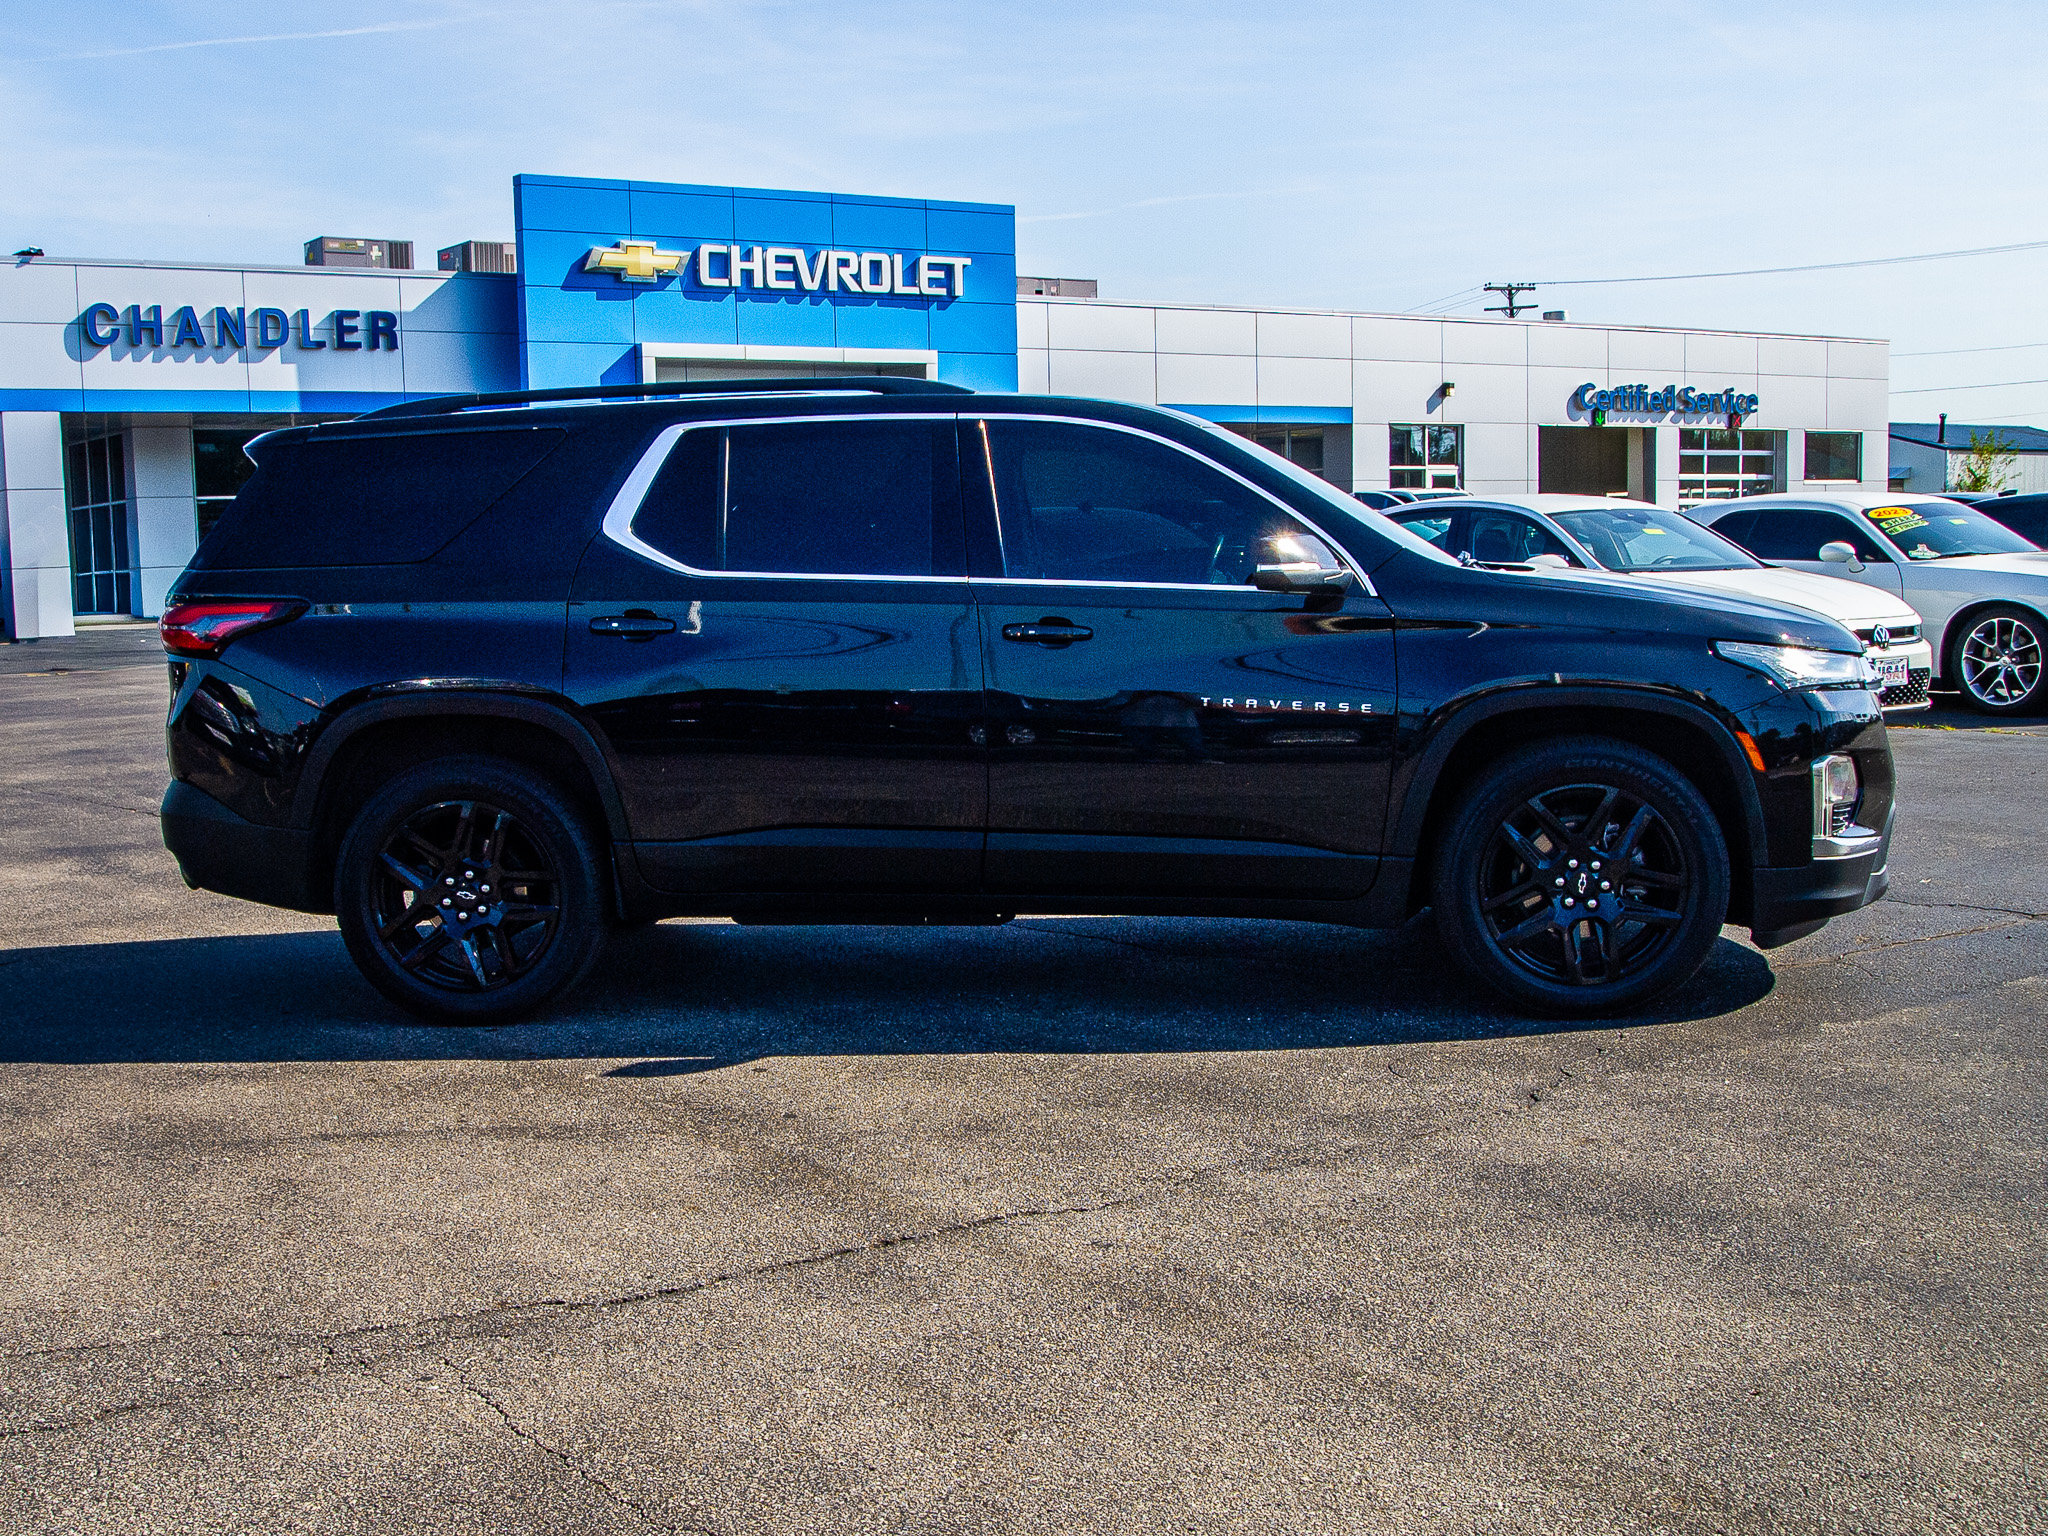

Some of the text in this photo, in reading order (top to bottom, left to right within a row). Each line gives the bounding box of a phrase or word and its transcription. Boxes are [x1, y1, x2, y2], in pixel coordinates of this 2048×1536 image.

[699, 244, 972, 297] CHEVROLET
[85, 302, 399, 350] CHANDLER
[1580, 382, 1758, 414] Certified Service
[1874, 509, 1908, 517] 2023
[1200, 697, 1372, 714] TRAVERSE
